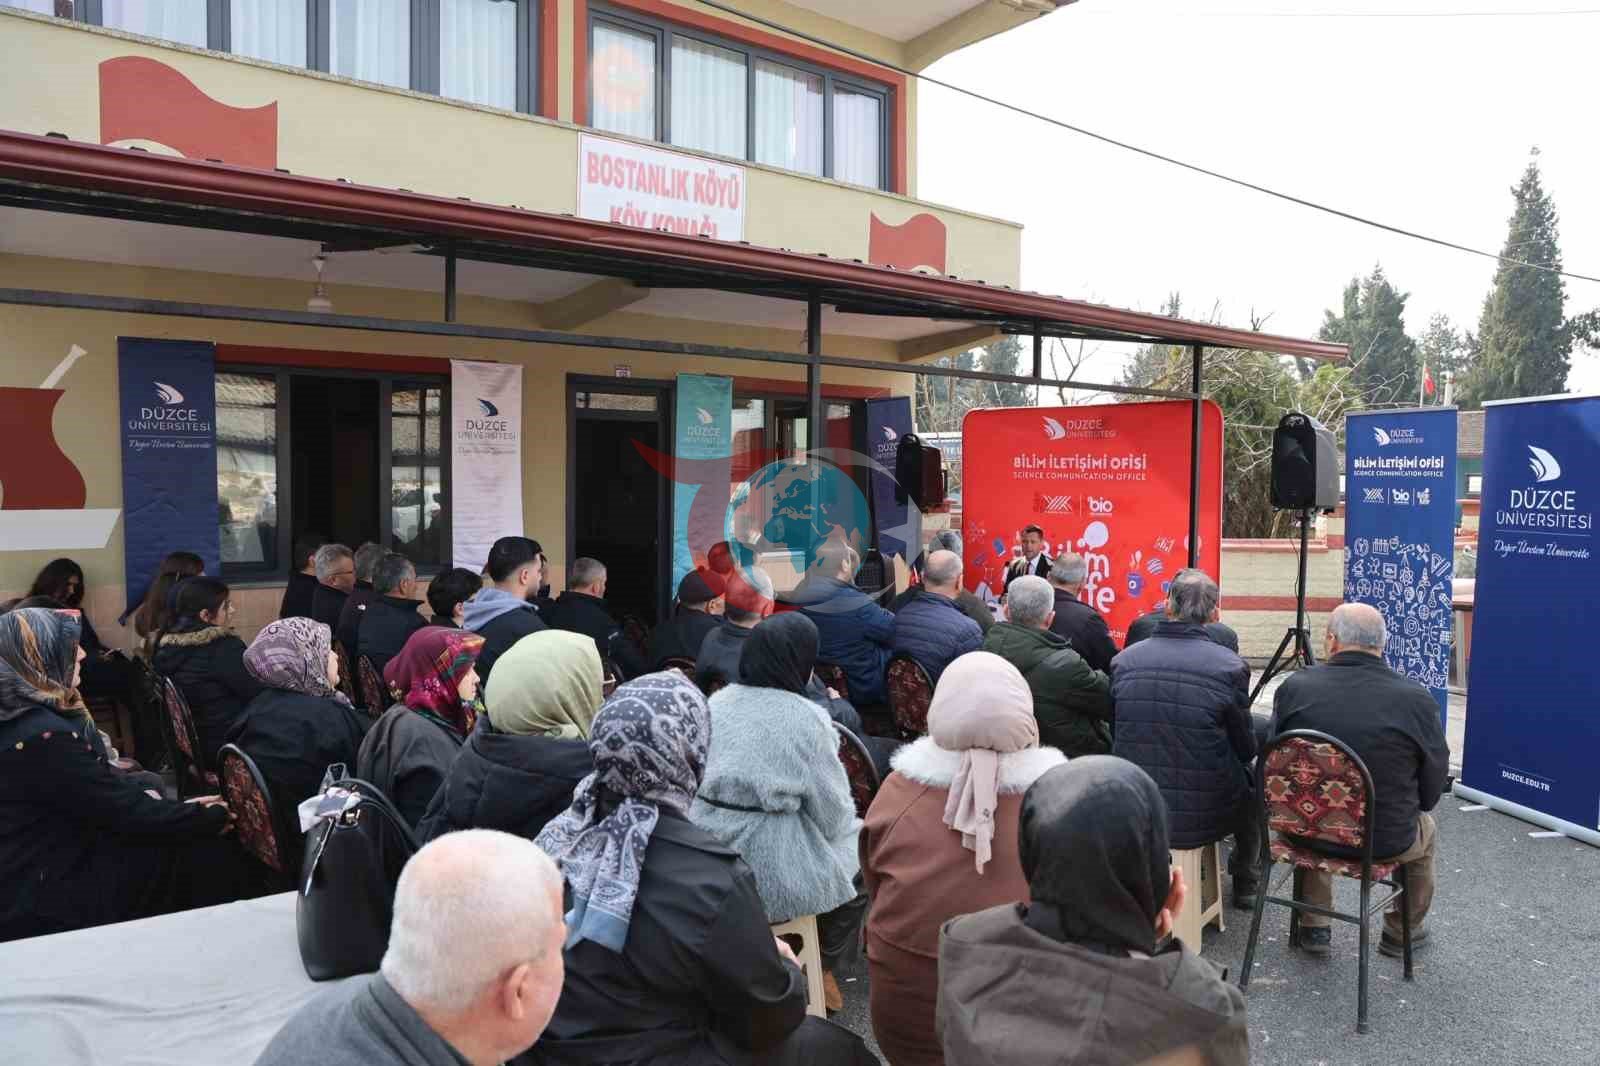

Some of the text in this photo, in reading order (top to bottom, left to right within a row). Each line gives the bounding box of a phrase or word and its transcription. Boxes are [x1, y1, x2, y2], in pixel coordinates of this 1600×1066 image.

[587, 151, 741, 210] BOSTANLIK KÖYÜ
[141, 406, 198, 421] DÜZCE
[1013, 453, 1148, 473] BİLİM İLETİŞİMİ OFİSİ
[1354, 456, 1444, 470] BİLİM İLETİŞİMİ OFİSİ
[1013, 471, 1147, 481] SCIENCE COMMUNICATION OFFICE
[1392, 488, 1410, 501] bio
[1510, 487, 1577, 510] DÜZCE
[1088, 496, 1113, 513] bio
[1496, 510, 1592, 529] ÜNİVERSİTESİ
